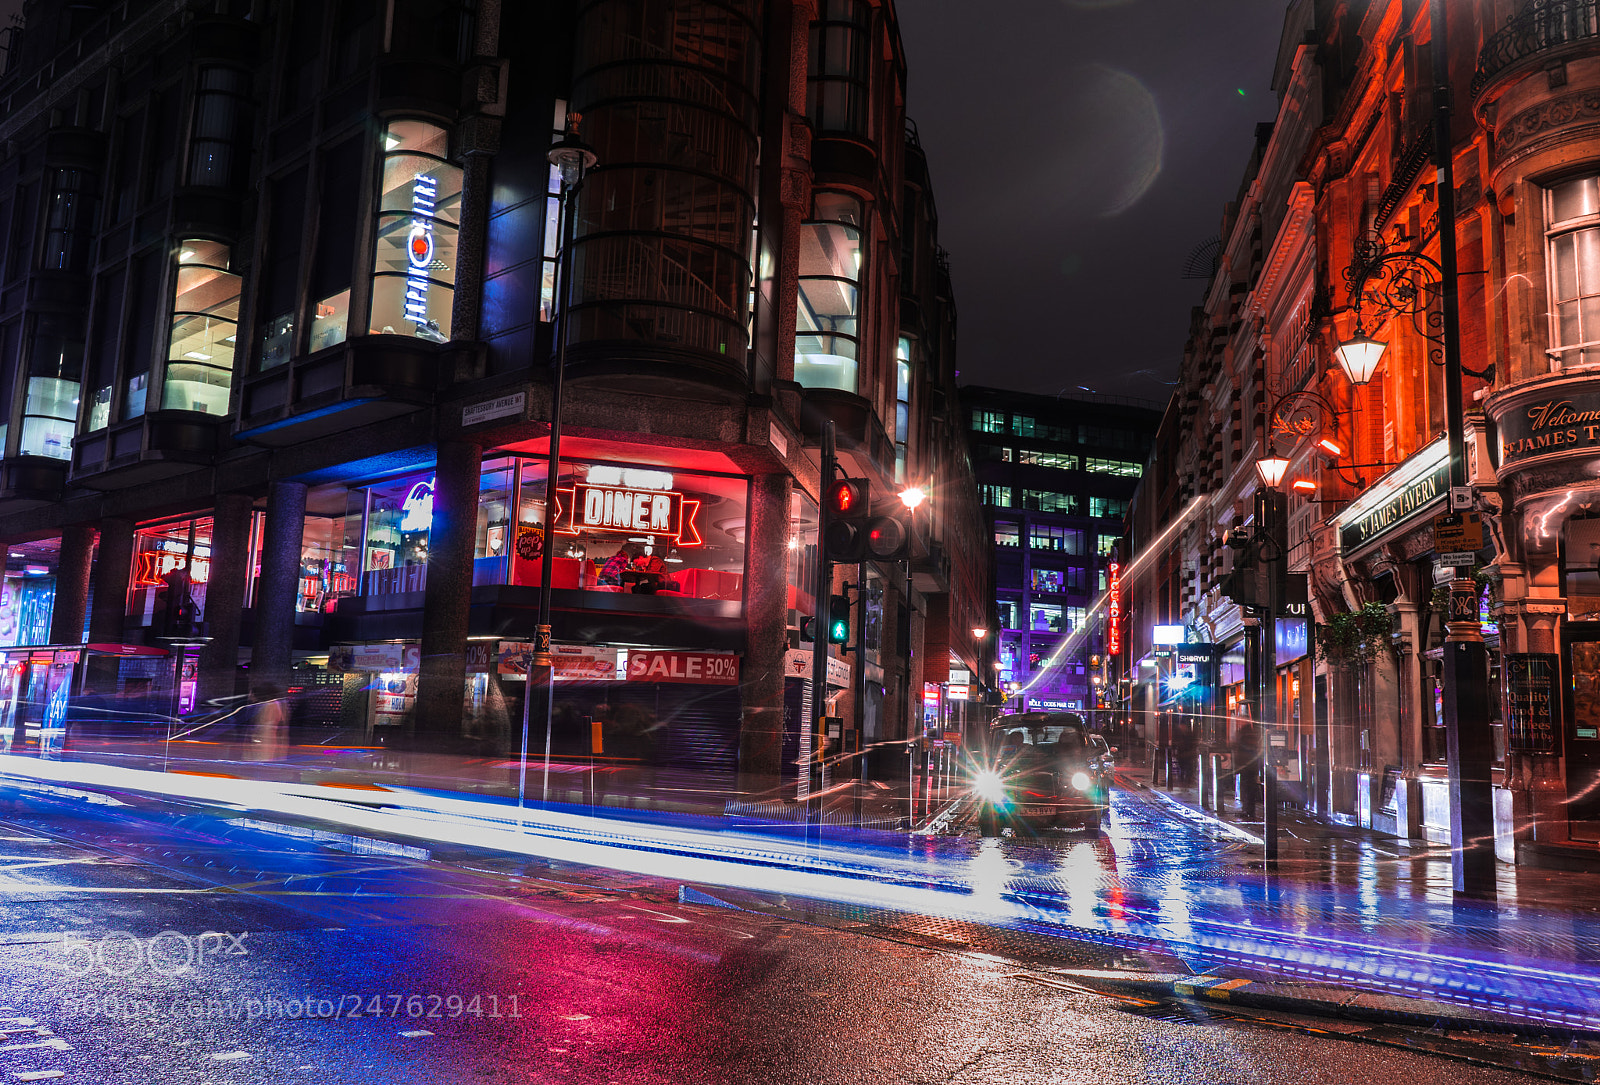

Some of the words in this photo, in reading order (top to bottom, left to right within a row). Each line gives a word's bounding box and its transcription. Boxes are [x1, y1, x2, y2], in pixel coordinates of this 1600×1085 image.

[496, 397, 514, 409] AVENUE
[1528, 401, 1600, 431] Welcome
[1517, 429, 1577, 453] JAMES
[584, 488, 671, 531] DINER
[1370, 501, 1397, 535] JAMES
[1398, 474, 1437, 517] TAVERN
[1110, 563, 1119, 655] PICCADILLY
[630, 653, 702, 679] SALE
[705, 658, 737, 677] 50%
[1510, 691, 1549, 705] Quality
[1510, 706, 1535, 716] Food
[1538, 706, 1549, 716] &
[1510, 718, 1551, 730] Coffees
